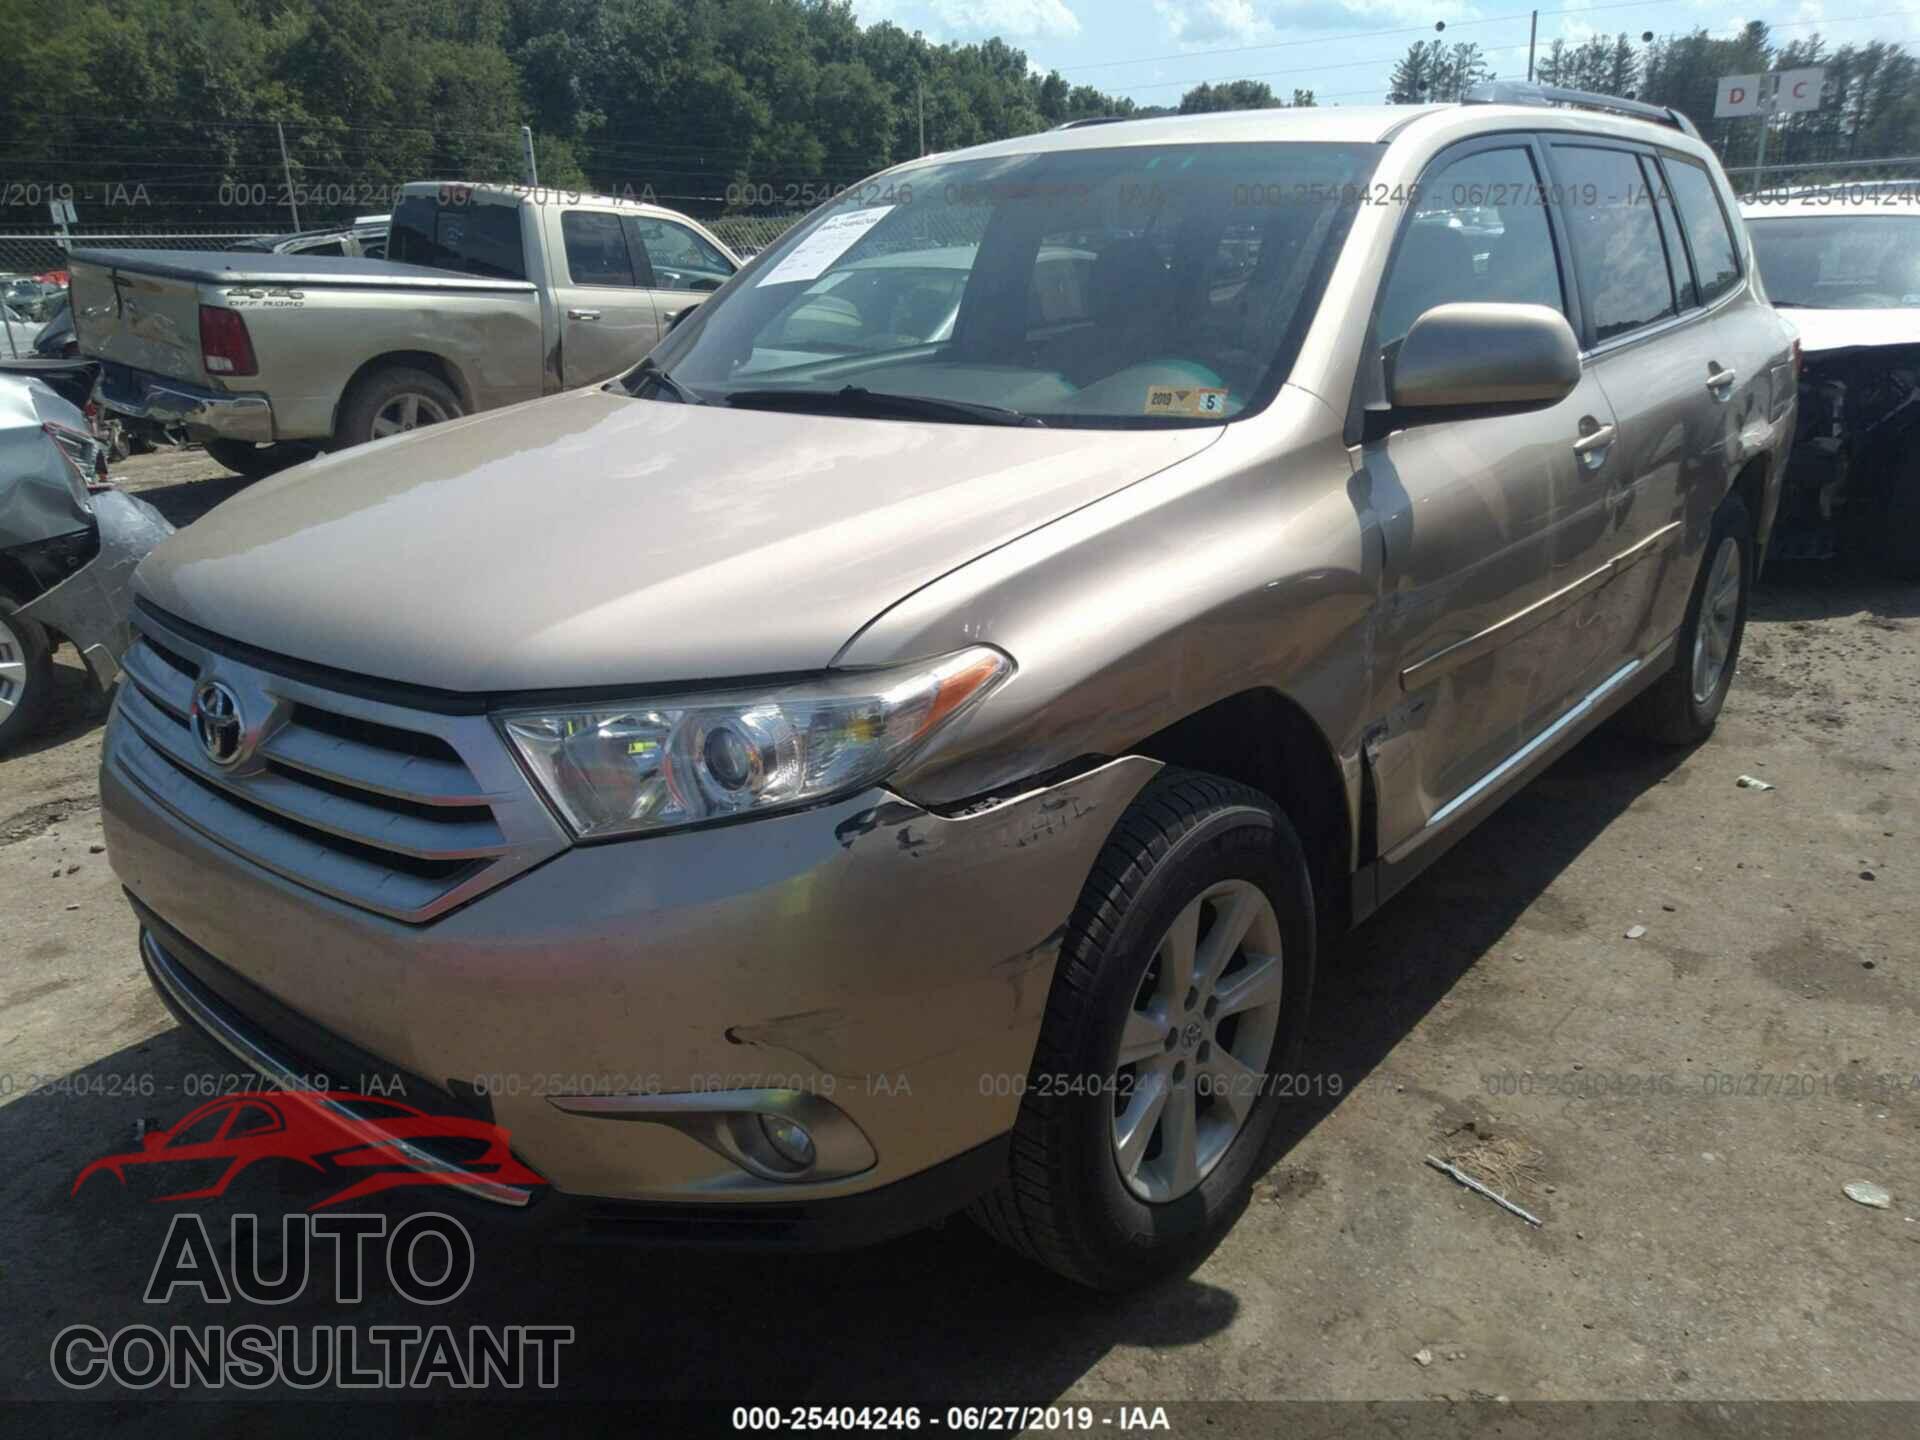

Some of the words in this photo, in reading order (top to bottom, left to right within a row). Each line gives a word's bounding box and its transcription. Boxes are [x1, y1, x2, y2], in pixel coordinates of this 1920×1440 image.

[1729, 88, 1745, 104] D
[1793, 81, 1809, 98] C
[1206, 395, 1216, 410] 5
